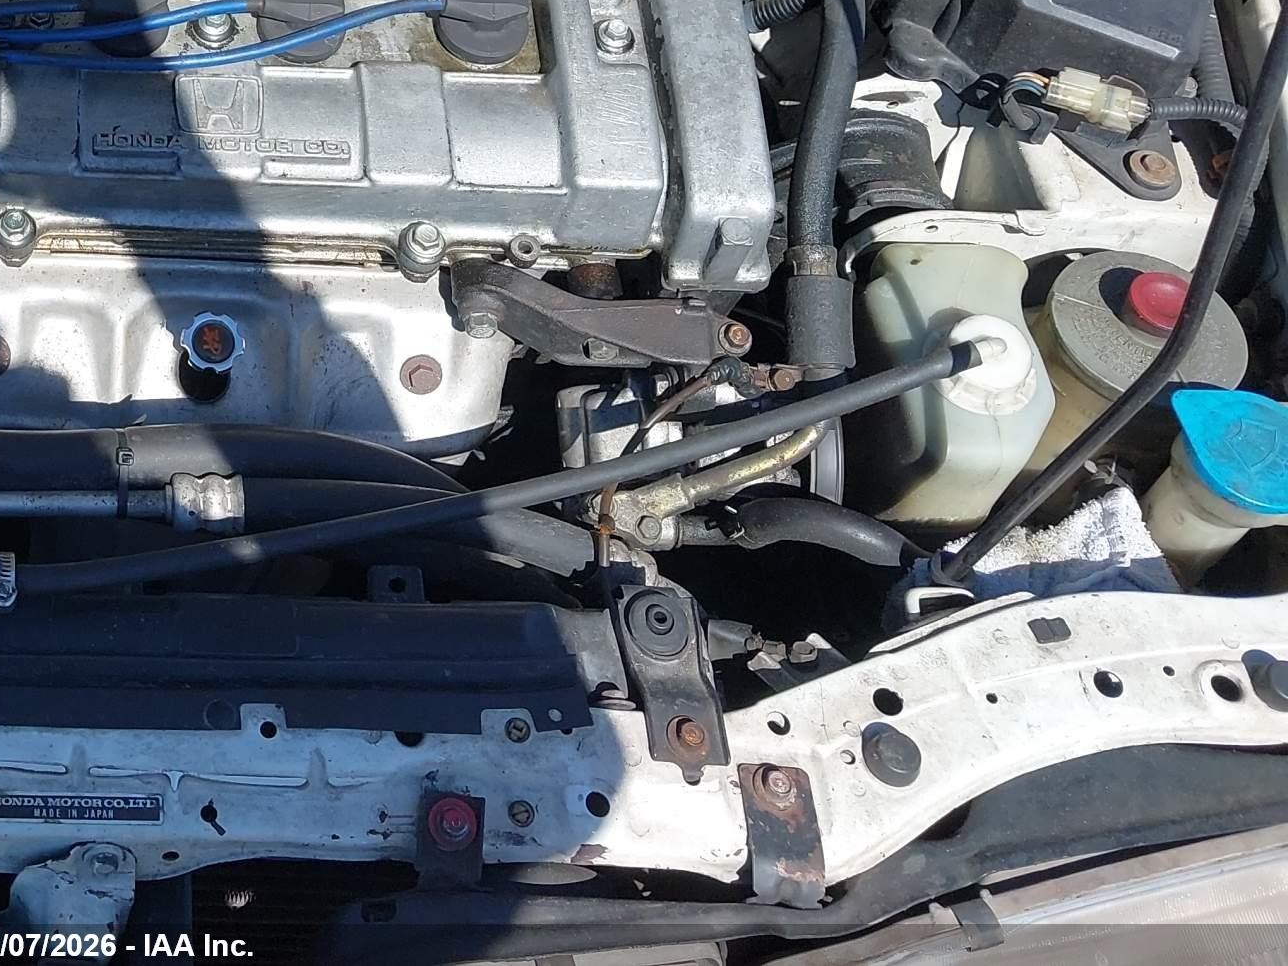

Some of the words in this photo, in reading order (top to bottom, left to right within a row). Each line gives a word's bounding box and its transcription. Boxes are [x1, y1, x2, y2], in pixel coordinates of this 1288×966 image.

[94, 131, 185, 150] HONDA
[198, 136, 294, 153] MOTOR
[48, 797, 103, 808] MOTOR
[33, 808, 62, 818] MADE
[67, 809, 78, 818] IN
[83, 809, 115, 819] JAPAN
